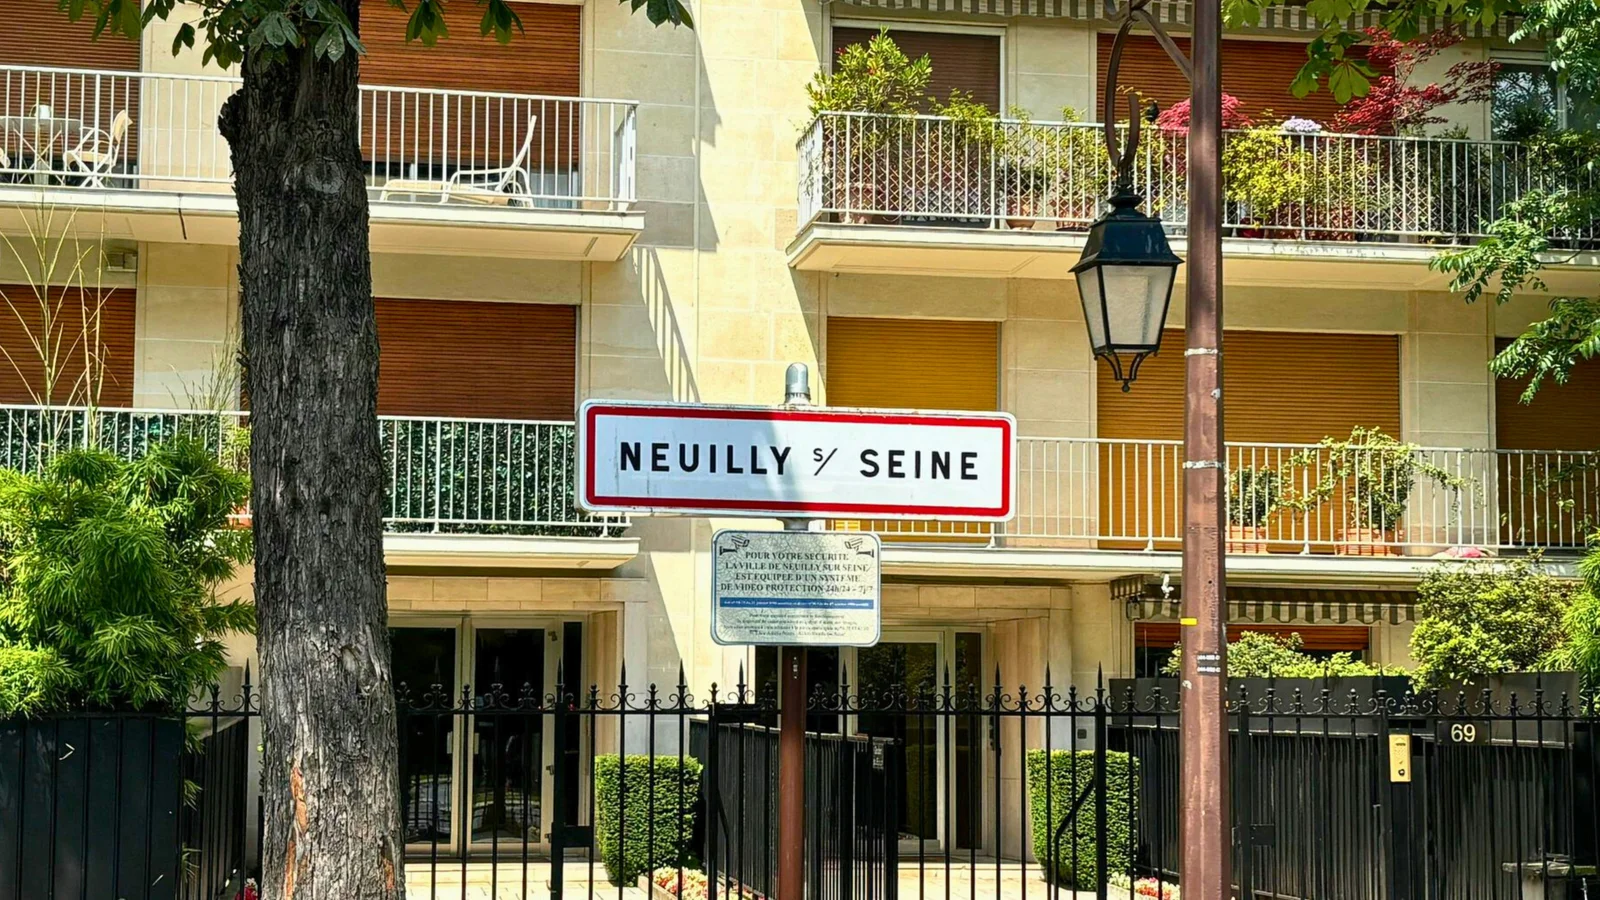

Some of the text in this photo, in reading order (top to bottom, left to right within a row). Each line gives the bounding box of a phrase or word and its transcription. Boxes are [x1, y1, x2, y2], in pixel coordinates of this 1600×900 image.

[620, 442, 791, 475] NEUILLY
[860, 449, 978, 480] SEINE
[745, 551, 770, 559] POUR
[772, 552, 802, 560] VOTRE
[739, 562, 767, 570] VILLE
[768, 562, 780, 570] DE
[783, 562, 820, 571] NEUILLY
[823, 563, 840, 571] SUR
[842, 563, 868, 572] SEINE
[735, 572, 752, 580] EST
[795, 573, 817, 581] D'UN
[720, 583, 732, 591] DE
[734, 583, 764, 591] VIDEO
[765, 584, 823, 592] PROTECTION
[1451, 723, 1476, 742] 69
